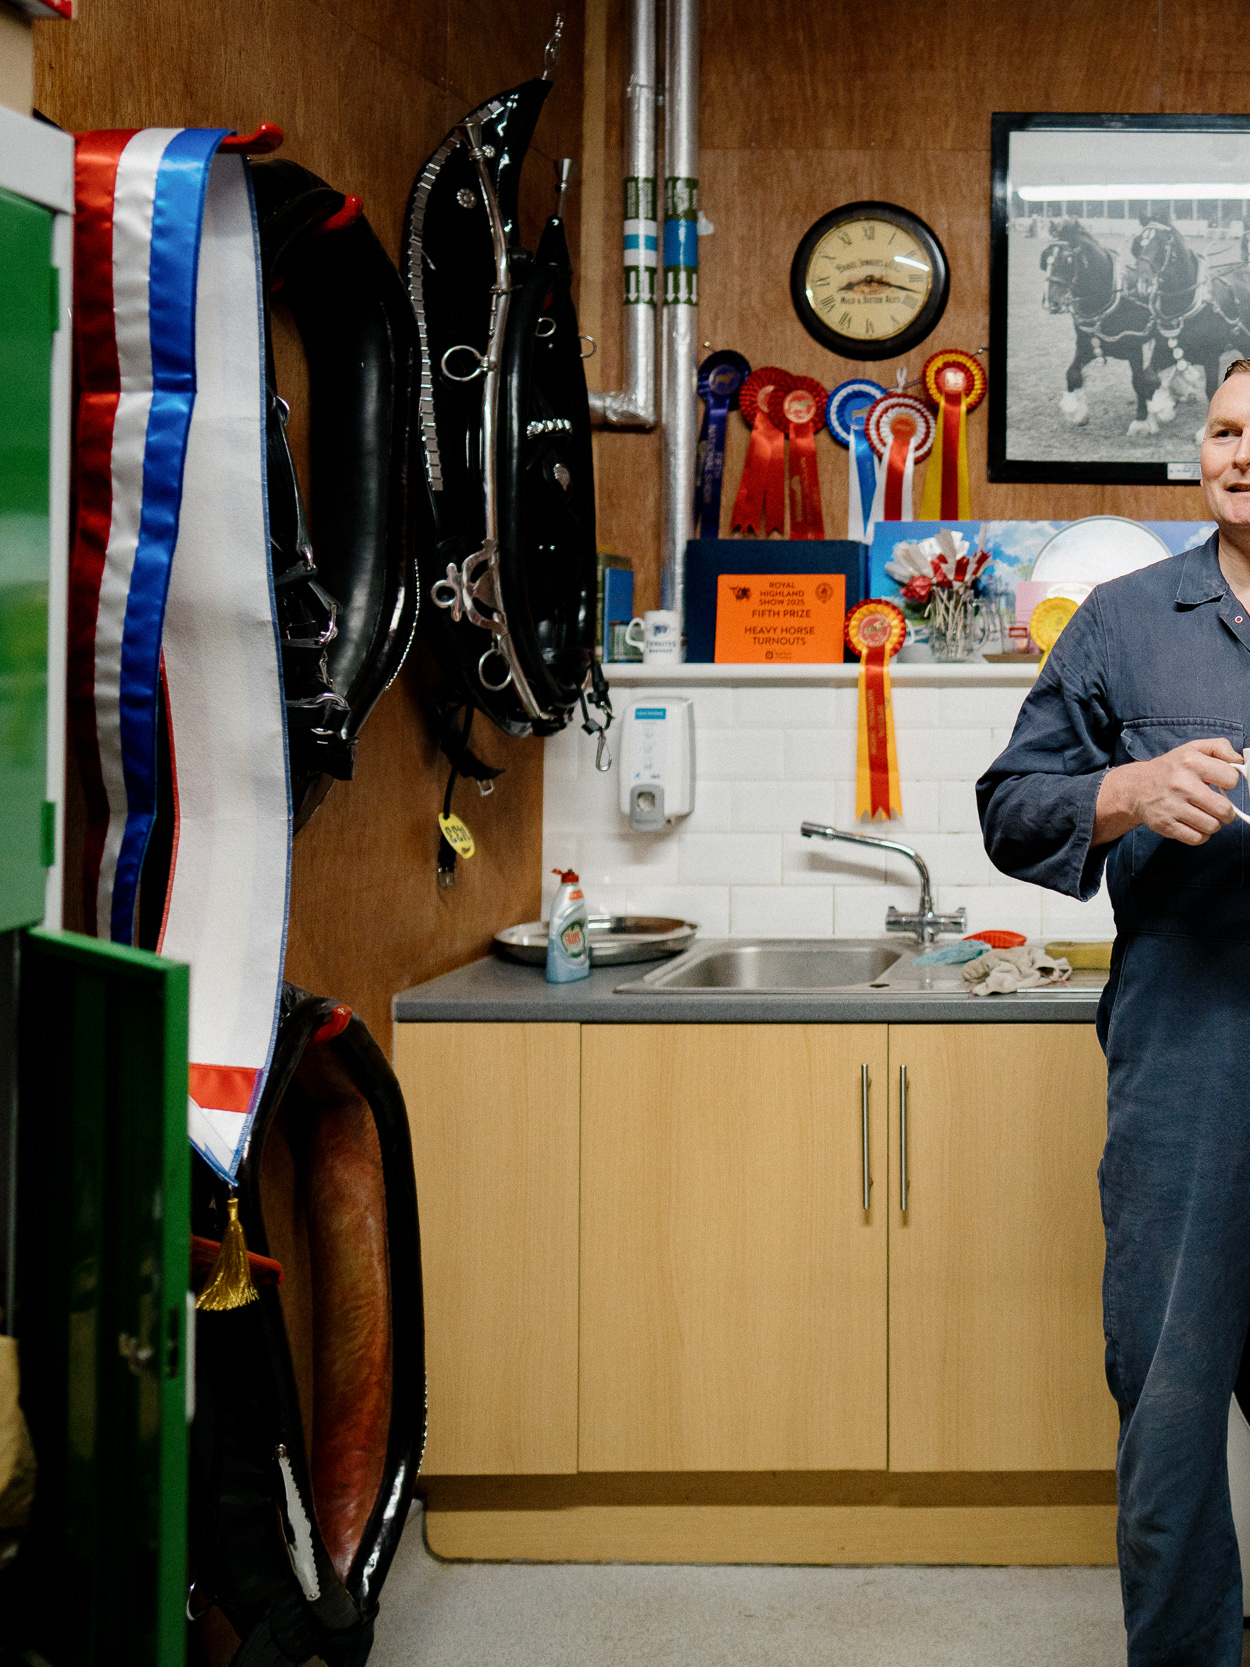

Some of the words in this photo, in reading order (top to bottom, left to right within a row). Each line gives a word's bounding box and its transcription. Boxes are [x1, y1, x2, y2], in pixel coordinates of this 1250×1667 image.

[759, 590, 805, 598] HIGHLAND
[752, 609, 780, 618] FIFTH
[783, 609, 811, 618] PRIZE
[744, 626, 777, 635] HEAVY
[780, 626, 815, 635] HORSE
[752, 636, 806, 646] TURNOUTS
